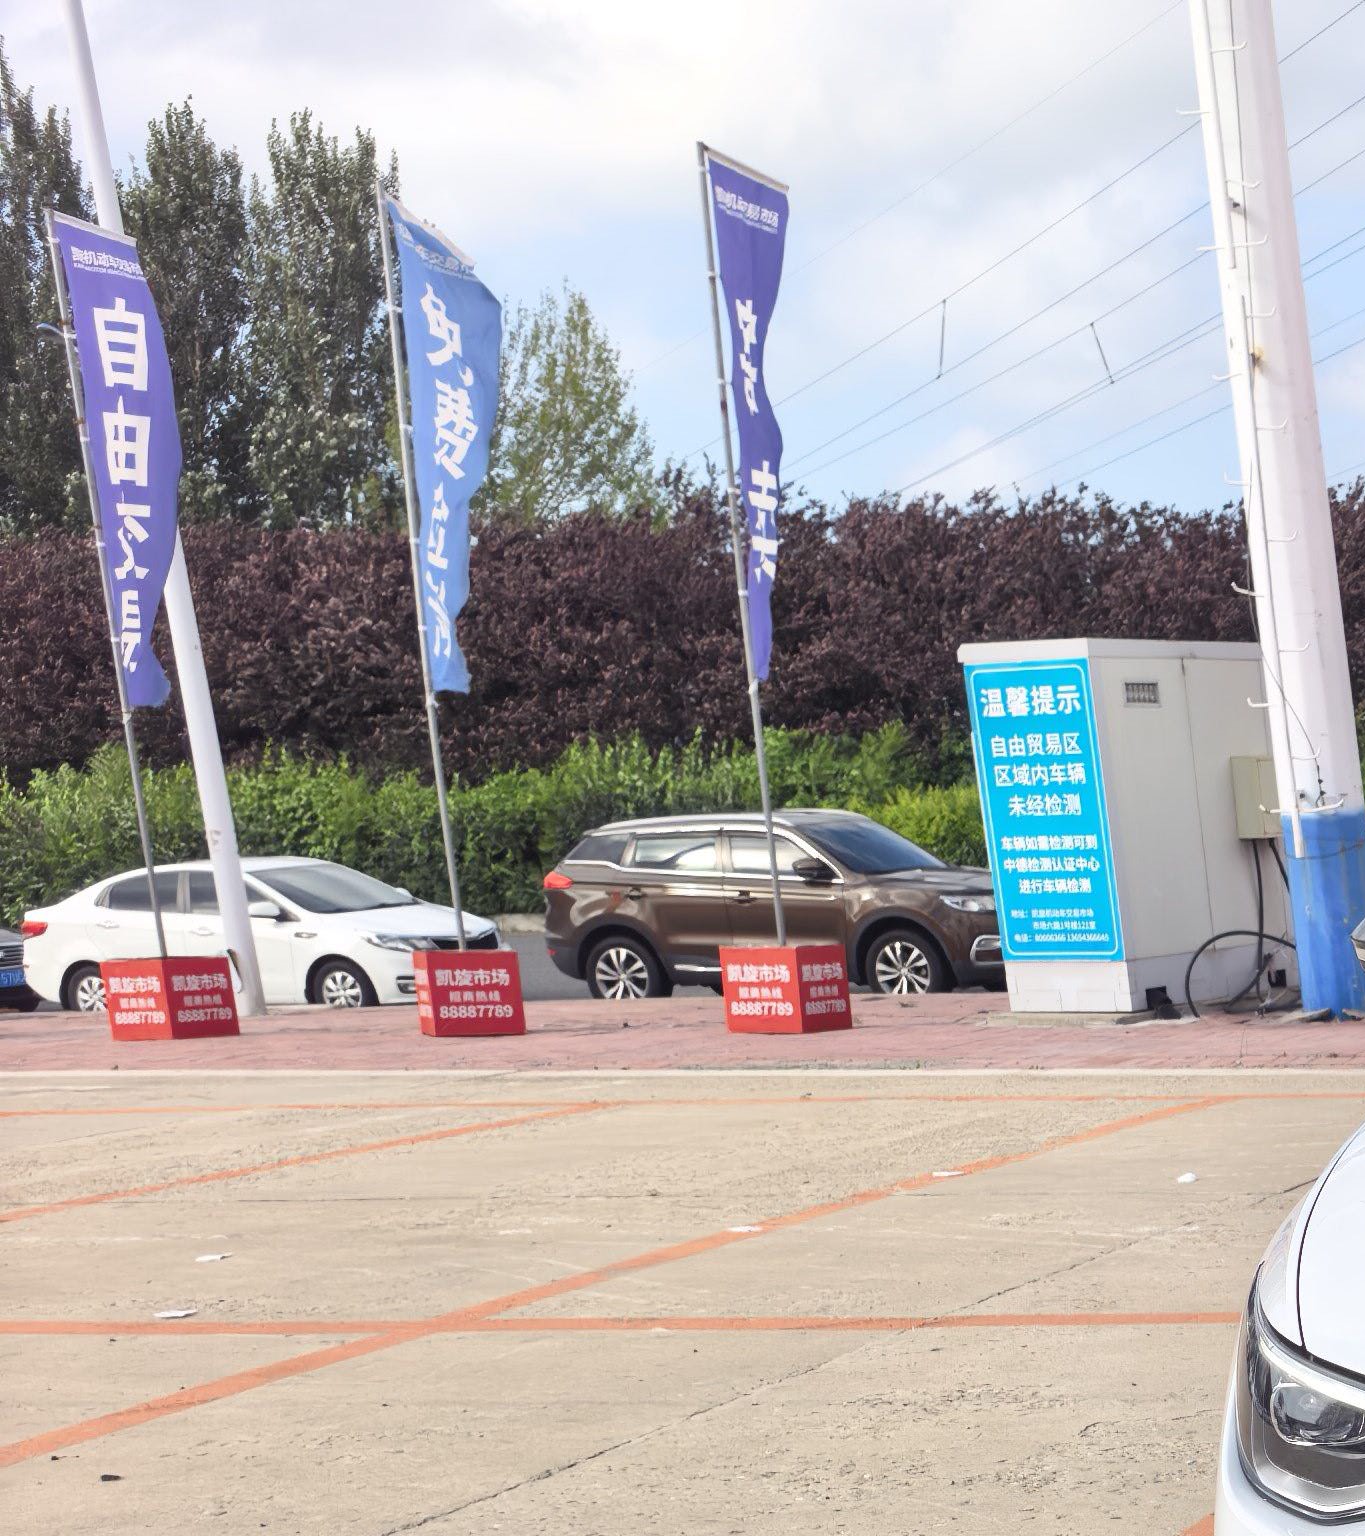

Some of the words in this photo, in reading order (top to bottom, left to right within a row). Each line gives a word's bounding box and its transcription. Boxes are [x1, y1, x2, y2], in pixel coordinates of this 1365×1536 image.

[980, 684, 1081, 717] 温馨提示
[990, 732, 1083, 758] 自由贸易区
[993, 762, 1087, 787] 区域内车辆
[1008, 793, 1082, 817] 未经检测
[1001, 834, 1098, 851] 车辆如需检测可到
[434, 968, 510, 986] 凯旋市场
[726, 963, 791, 983] 凯旋市场
[114, 1011, 166, 1024] 88887789
[439, 1004, 514, 1018] 88887789
[730, 1001, 794, 1016] 88887789
